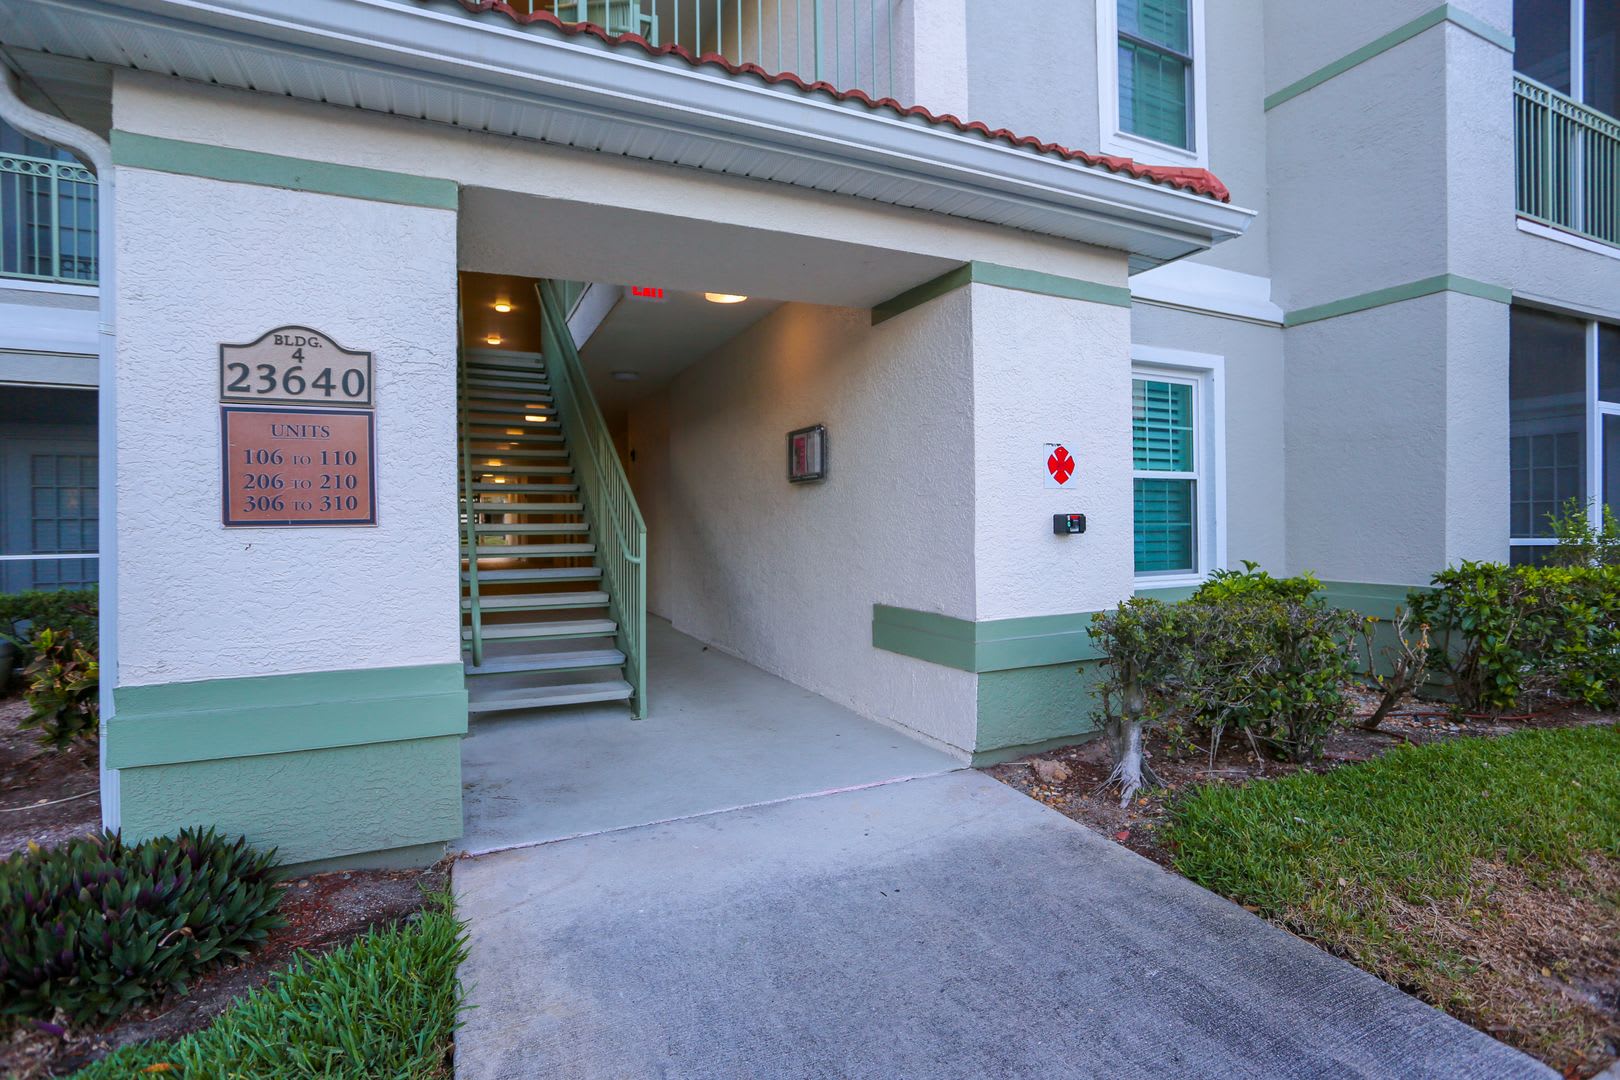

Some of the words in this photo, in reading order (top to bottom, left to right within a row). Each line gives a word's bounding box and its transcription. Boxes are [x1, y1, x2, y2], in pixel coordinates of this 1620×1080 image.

[274, 335, 322, 348] BLDG.
[292, 348, 304, 363] 4
[227, 363, 365, 397] 23640
[272, 424, 330, 438] UNITS
[244, 449, 283, 465] 106
[321, 451, 357, 465] 110
[243, 474, 284, 489] 206
[319, 474, 357, 489] 210
[243, 495, 284, 512] 306
[319, 496, 358, 511] 310
